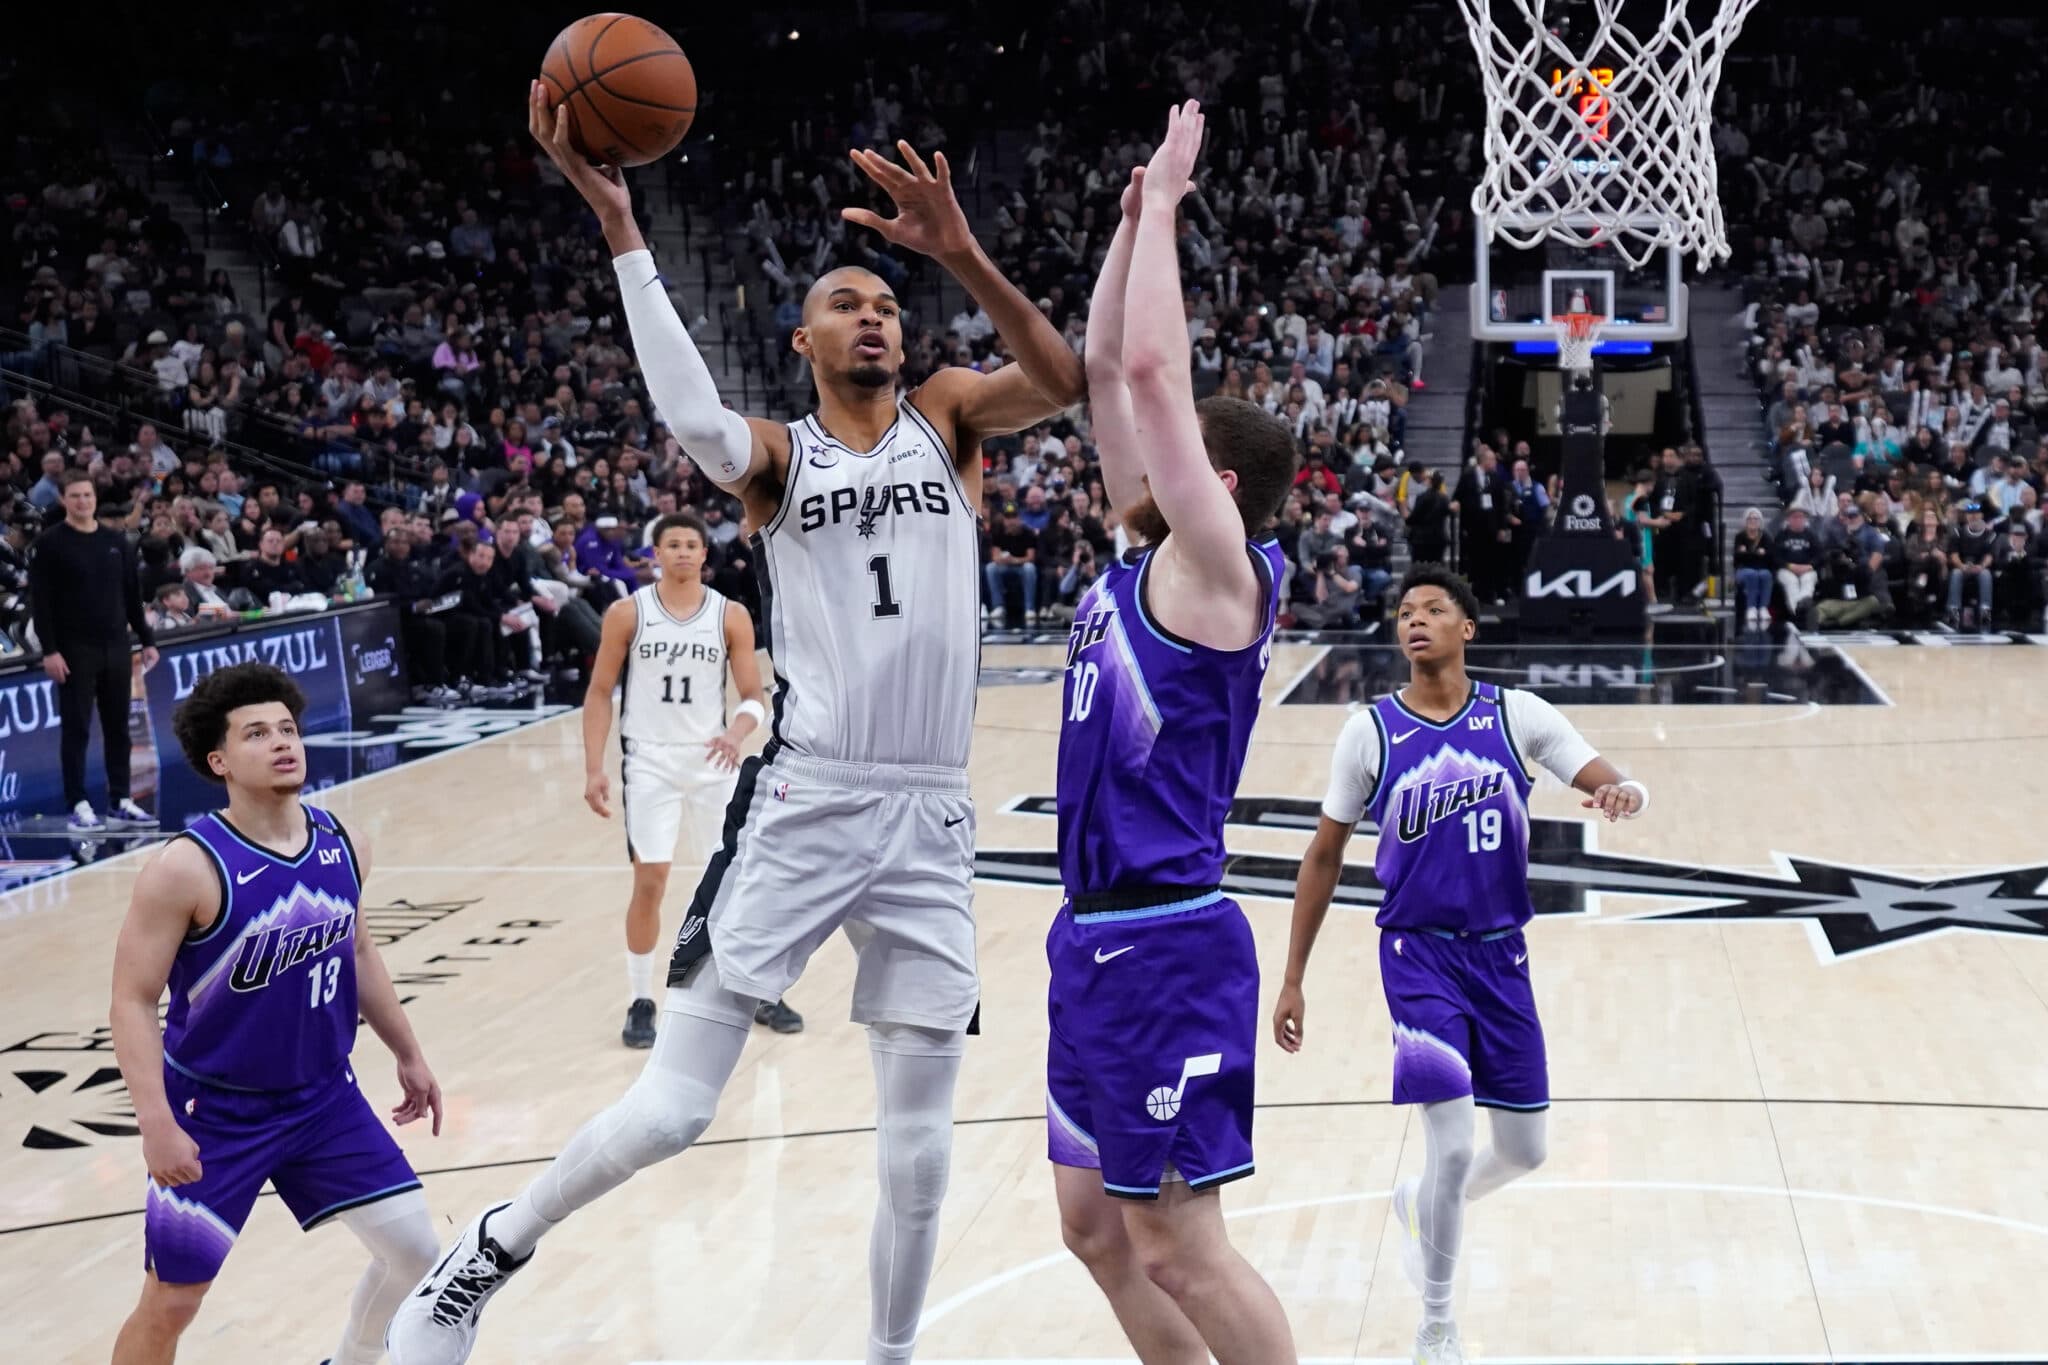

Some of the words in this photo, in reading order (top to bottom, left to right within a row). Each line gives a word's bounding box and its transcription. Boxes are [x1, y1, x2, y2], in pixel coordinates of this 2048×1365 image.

[800, 481, 951, 539] SPURS
[1565, 515, 1602, 531] Frost
[867, 553, 903, 620] 1
[639, 641, 720, 667] SPURS
[661, 674, 693, 704] 11
[1068, 661, 1099, 722] 10
[1468, 716, 1495, 731] LVT
[1397, 768, 1508, 844] UTAH
[1462, 808, 1503, 854] 19
[318, 848, 341, 865] LVT
[228, 911, 355, 993] UTAH
[308, 956, 342, 1009] 13
